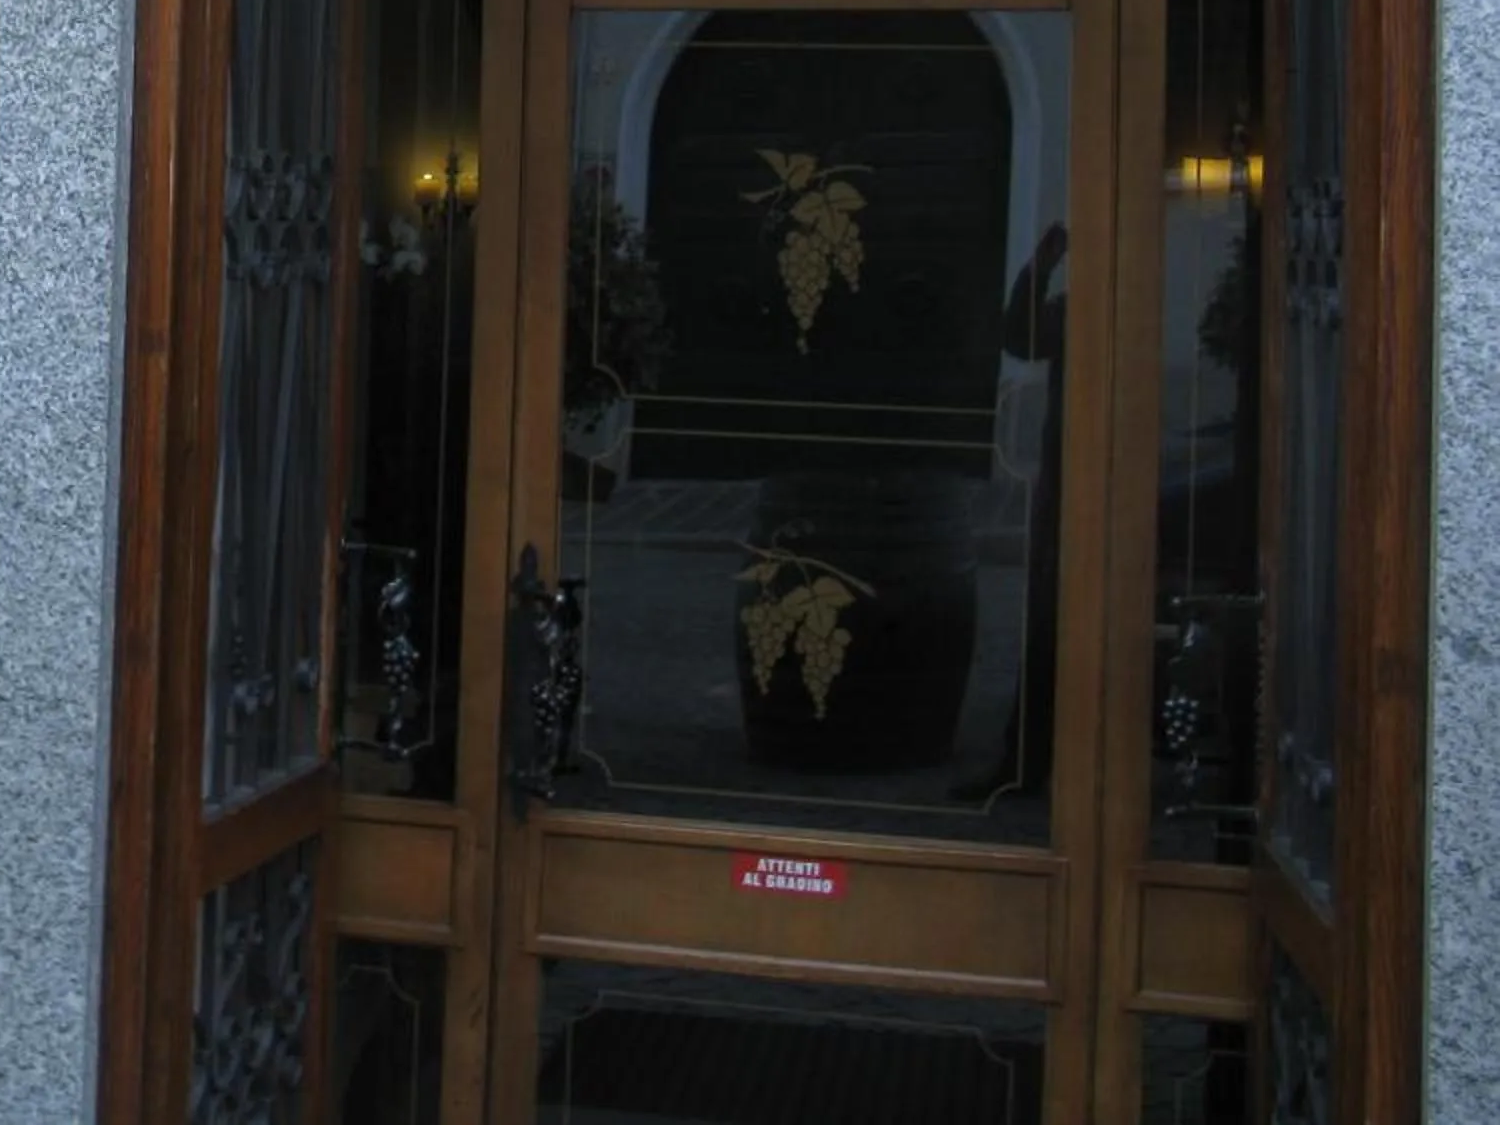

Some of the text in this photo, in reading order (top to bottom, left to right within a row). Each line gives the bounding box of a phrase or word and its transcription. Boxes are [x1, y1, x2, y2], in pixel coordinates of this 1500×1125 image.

[756, 858, 821, 876] ATTENTI
[742, 871, 834, 894] AL GRADINO
